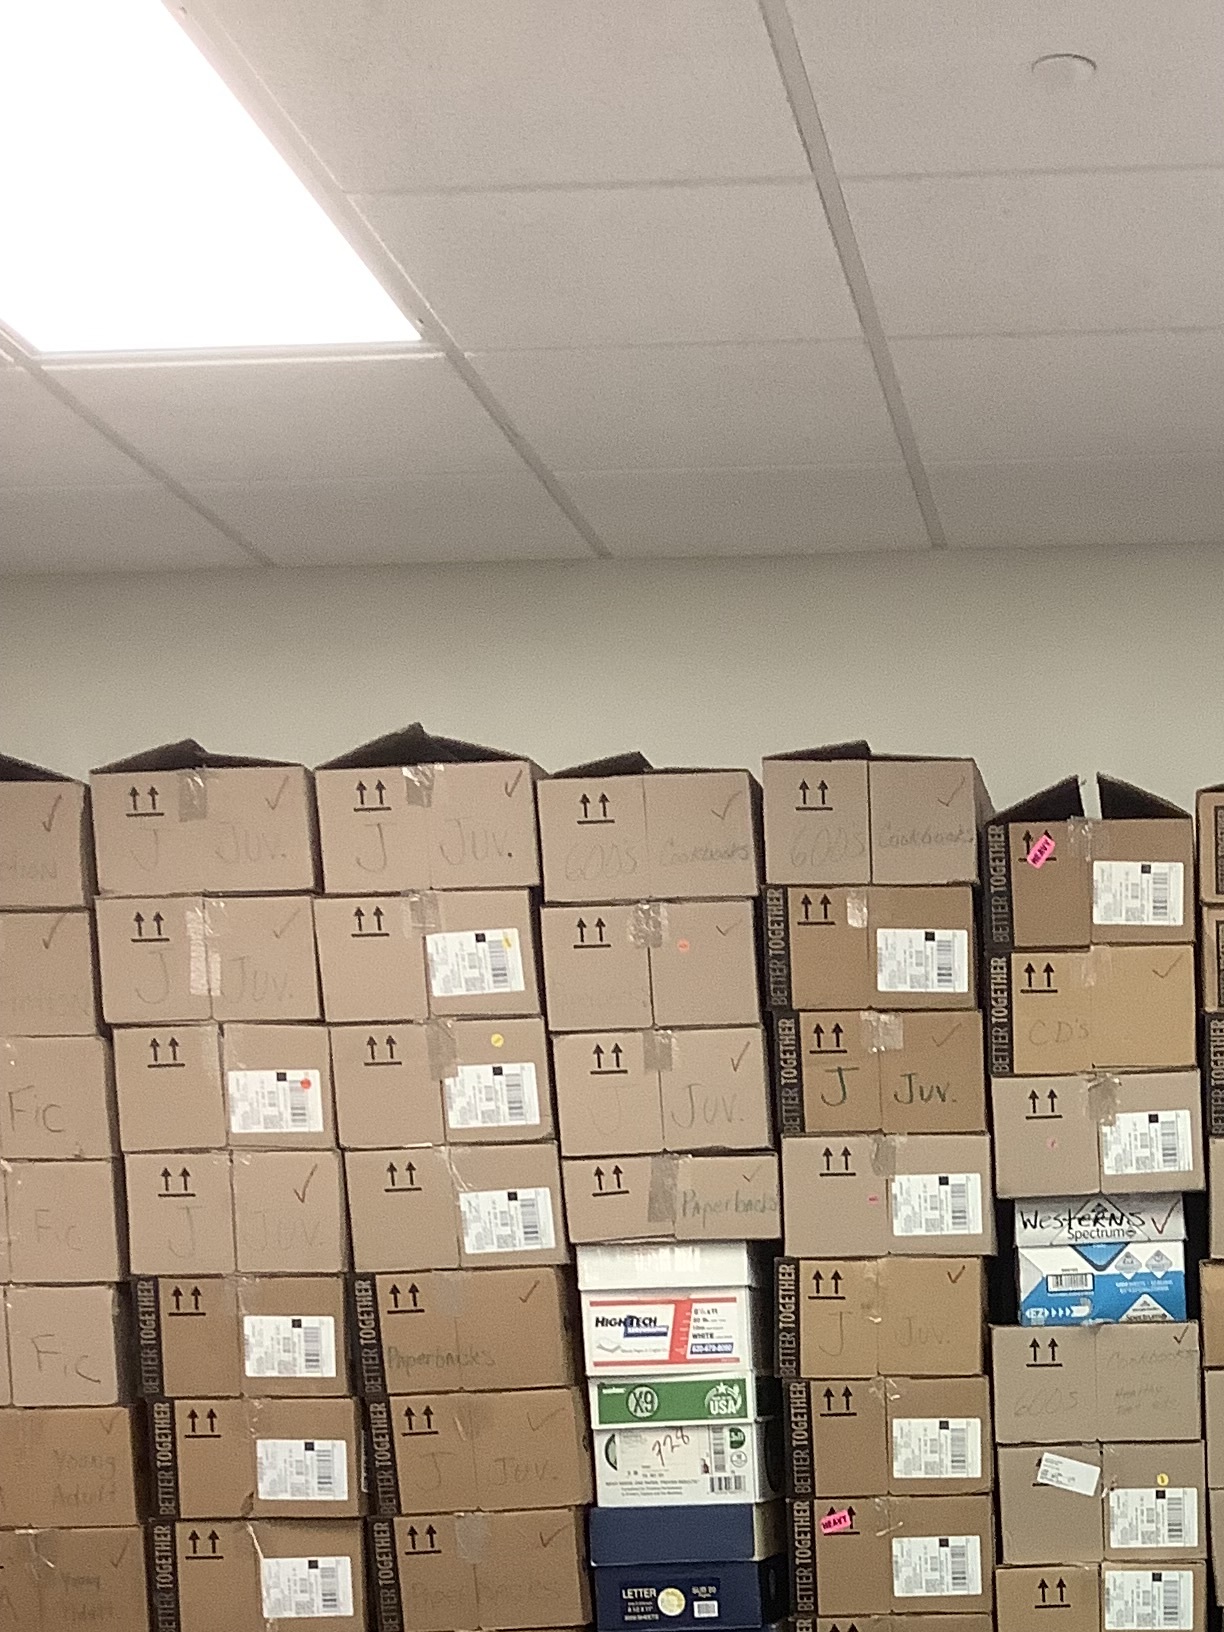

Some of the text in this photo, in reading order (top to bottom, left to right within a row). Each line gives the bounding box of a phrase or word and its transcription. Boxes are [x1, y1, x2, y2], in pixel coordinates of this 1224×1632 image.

[1030, 836, 1053, 866] HEAVY
[993, 958, 1007, 1021] TOGETHER
[780, 1019, 797, 1080] TOGETHER
[821, 1066, 957, 1108] J Juv.
[1067, 1228, 1125, 1241] Spectrum
[141, 1280, 155, 1346] TOGETHER
[357, 1279, 378, 1344] TOGETHER
[779, 1264, 797, 1328] TOGETHER
[155, 1403, 172, 1467] TOGETHER
[371, 1403, 391, 1467] TOGETHER
[710, 1399, 737, 1415] USA
[790, 1383, 807, 1446] TOGETHER
[796, 1501, 813, 1563] TOGETHER
[821, 1514, 849, 1529] HEAVY
[622, 1588, 657, 1599] LETTER
